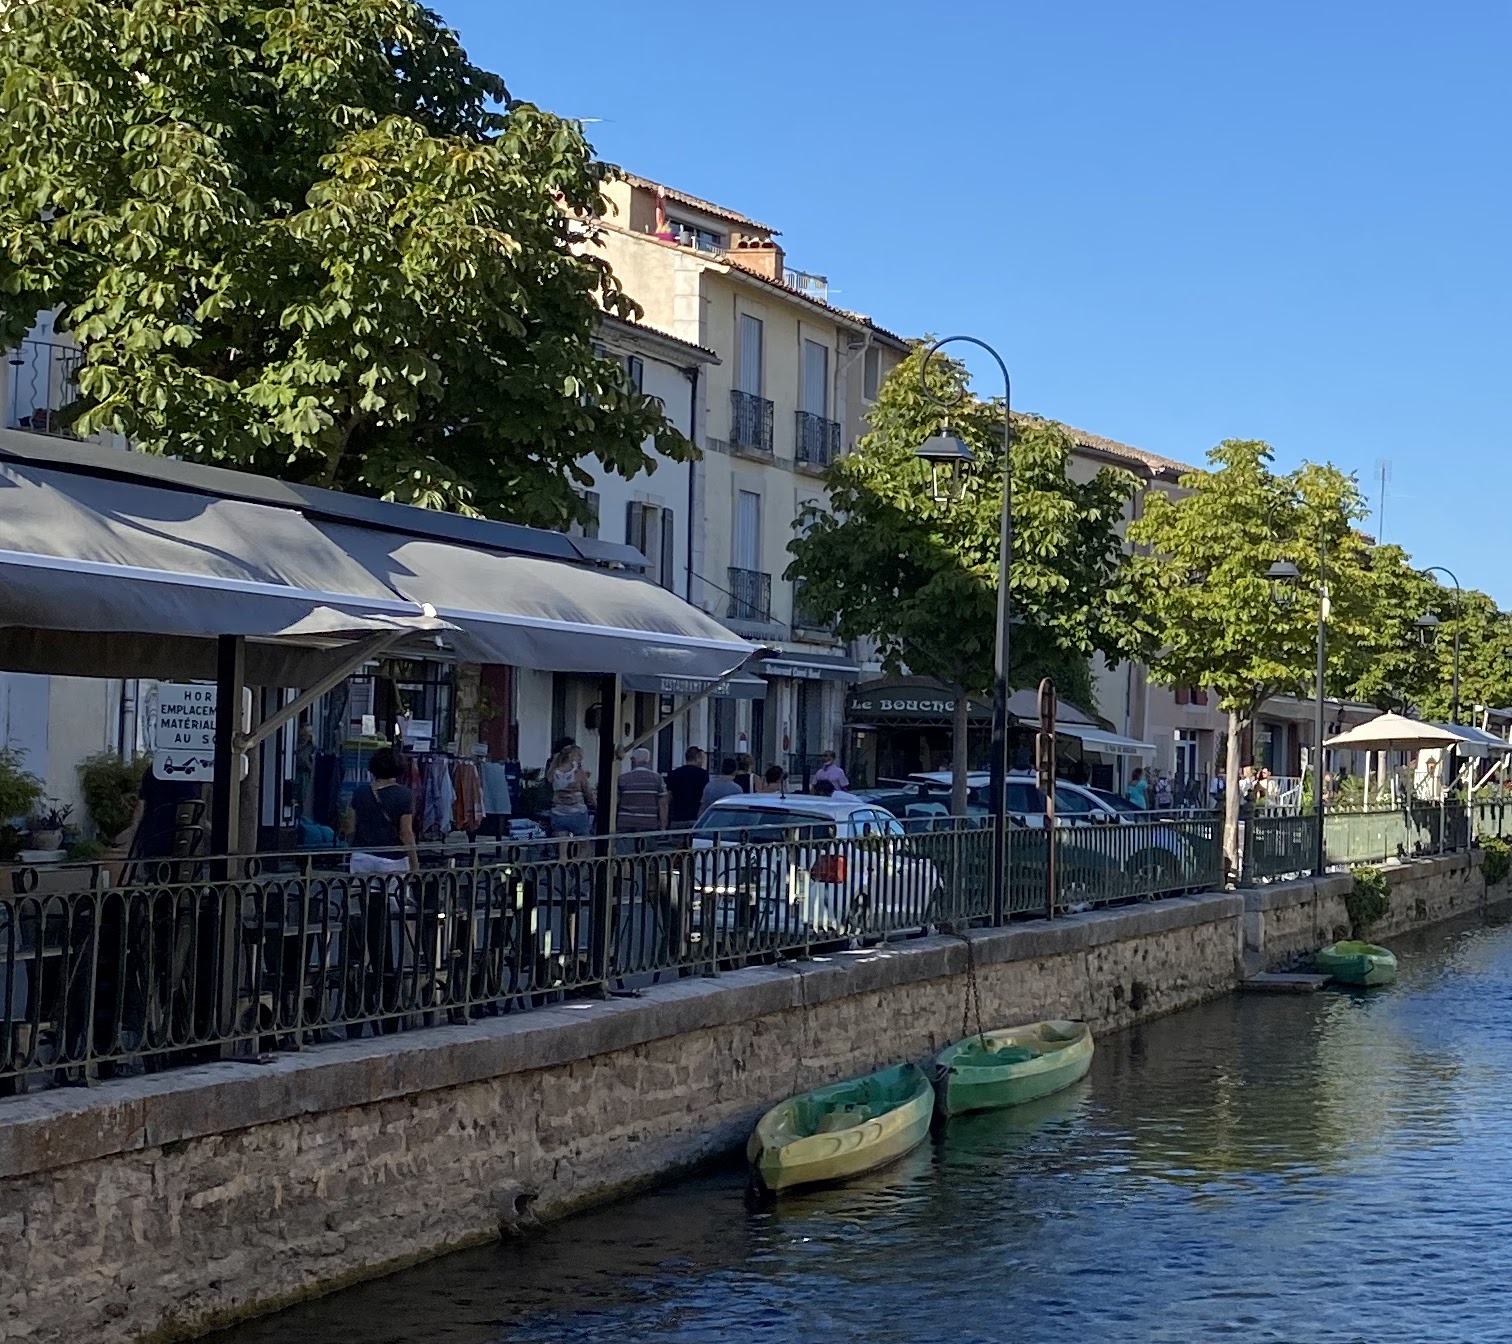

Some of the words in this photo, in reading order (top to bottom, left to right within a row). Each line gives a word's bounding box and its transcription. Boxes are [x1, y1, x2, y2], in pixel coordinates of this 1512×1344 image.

[184, 691, 212, 702] HOR
[161, 704, 217, 715] EMPLACEM
[160, 717, 217, 730] MATÉRIAL
[174, 733, 192, 744] AU
